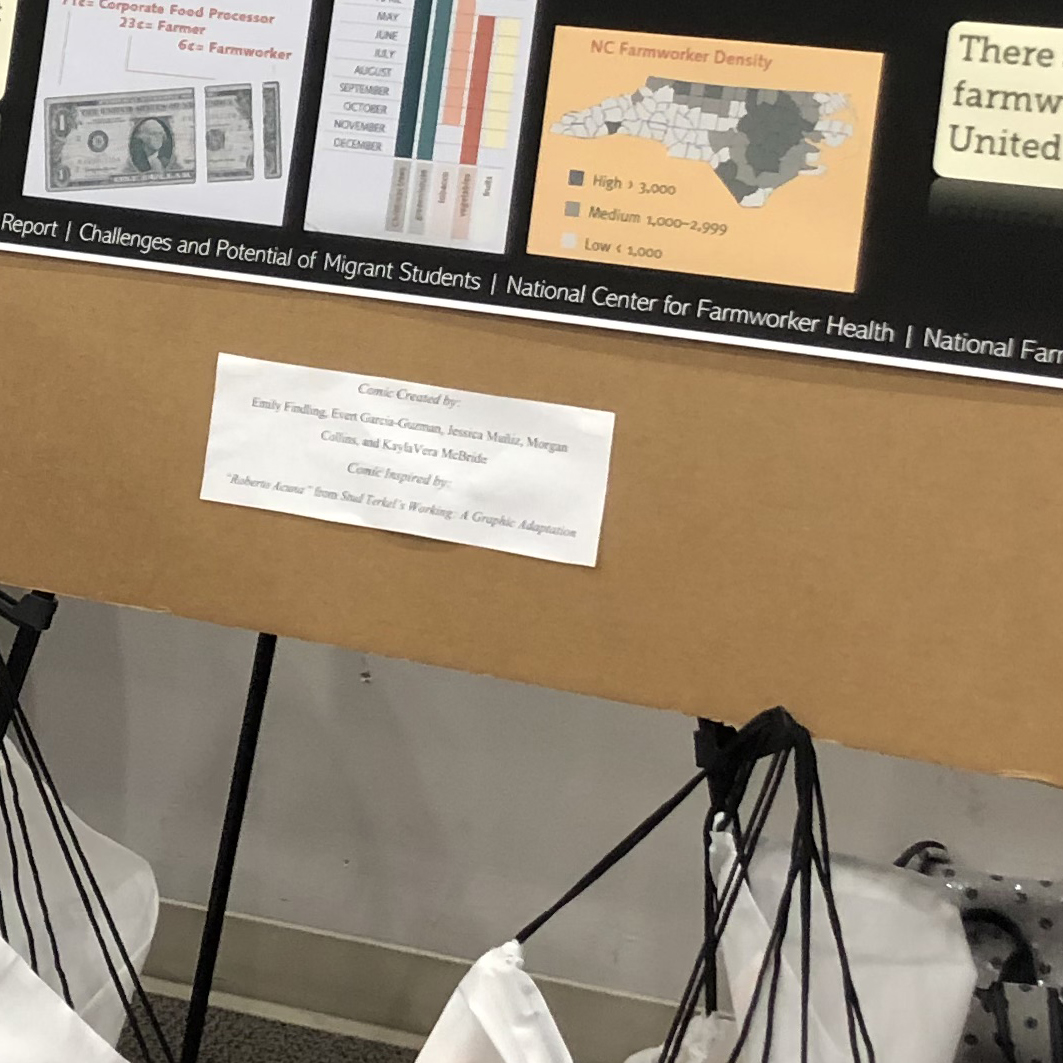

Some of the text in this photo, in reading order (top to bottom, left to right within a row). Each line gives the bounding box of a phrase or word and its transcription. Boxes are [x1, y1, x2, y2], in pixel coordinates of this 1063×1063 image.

[157, 19, 206, 35] Farmer
[169, 3, 204, 18] Food
[208, 7, 275, 24] Processor
[208, 41, 292, 60] Farmworker
[590, 39, 773, 72] NC Farmworker Density
[959, 34, 1055, 68] There
[949, 123, 1061, 161] United
[592, 174, 622, 191] High
[0, 212, 59, 238] Report
[588, 205, 641, 223] Medium
[79, 222, 481, 290] Challenges and Potential of Migrant Students
[506, 275, 895, 342] National Center for Farmworker Health
[923, 327, 1063, 364] National Far
